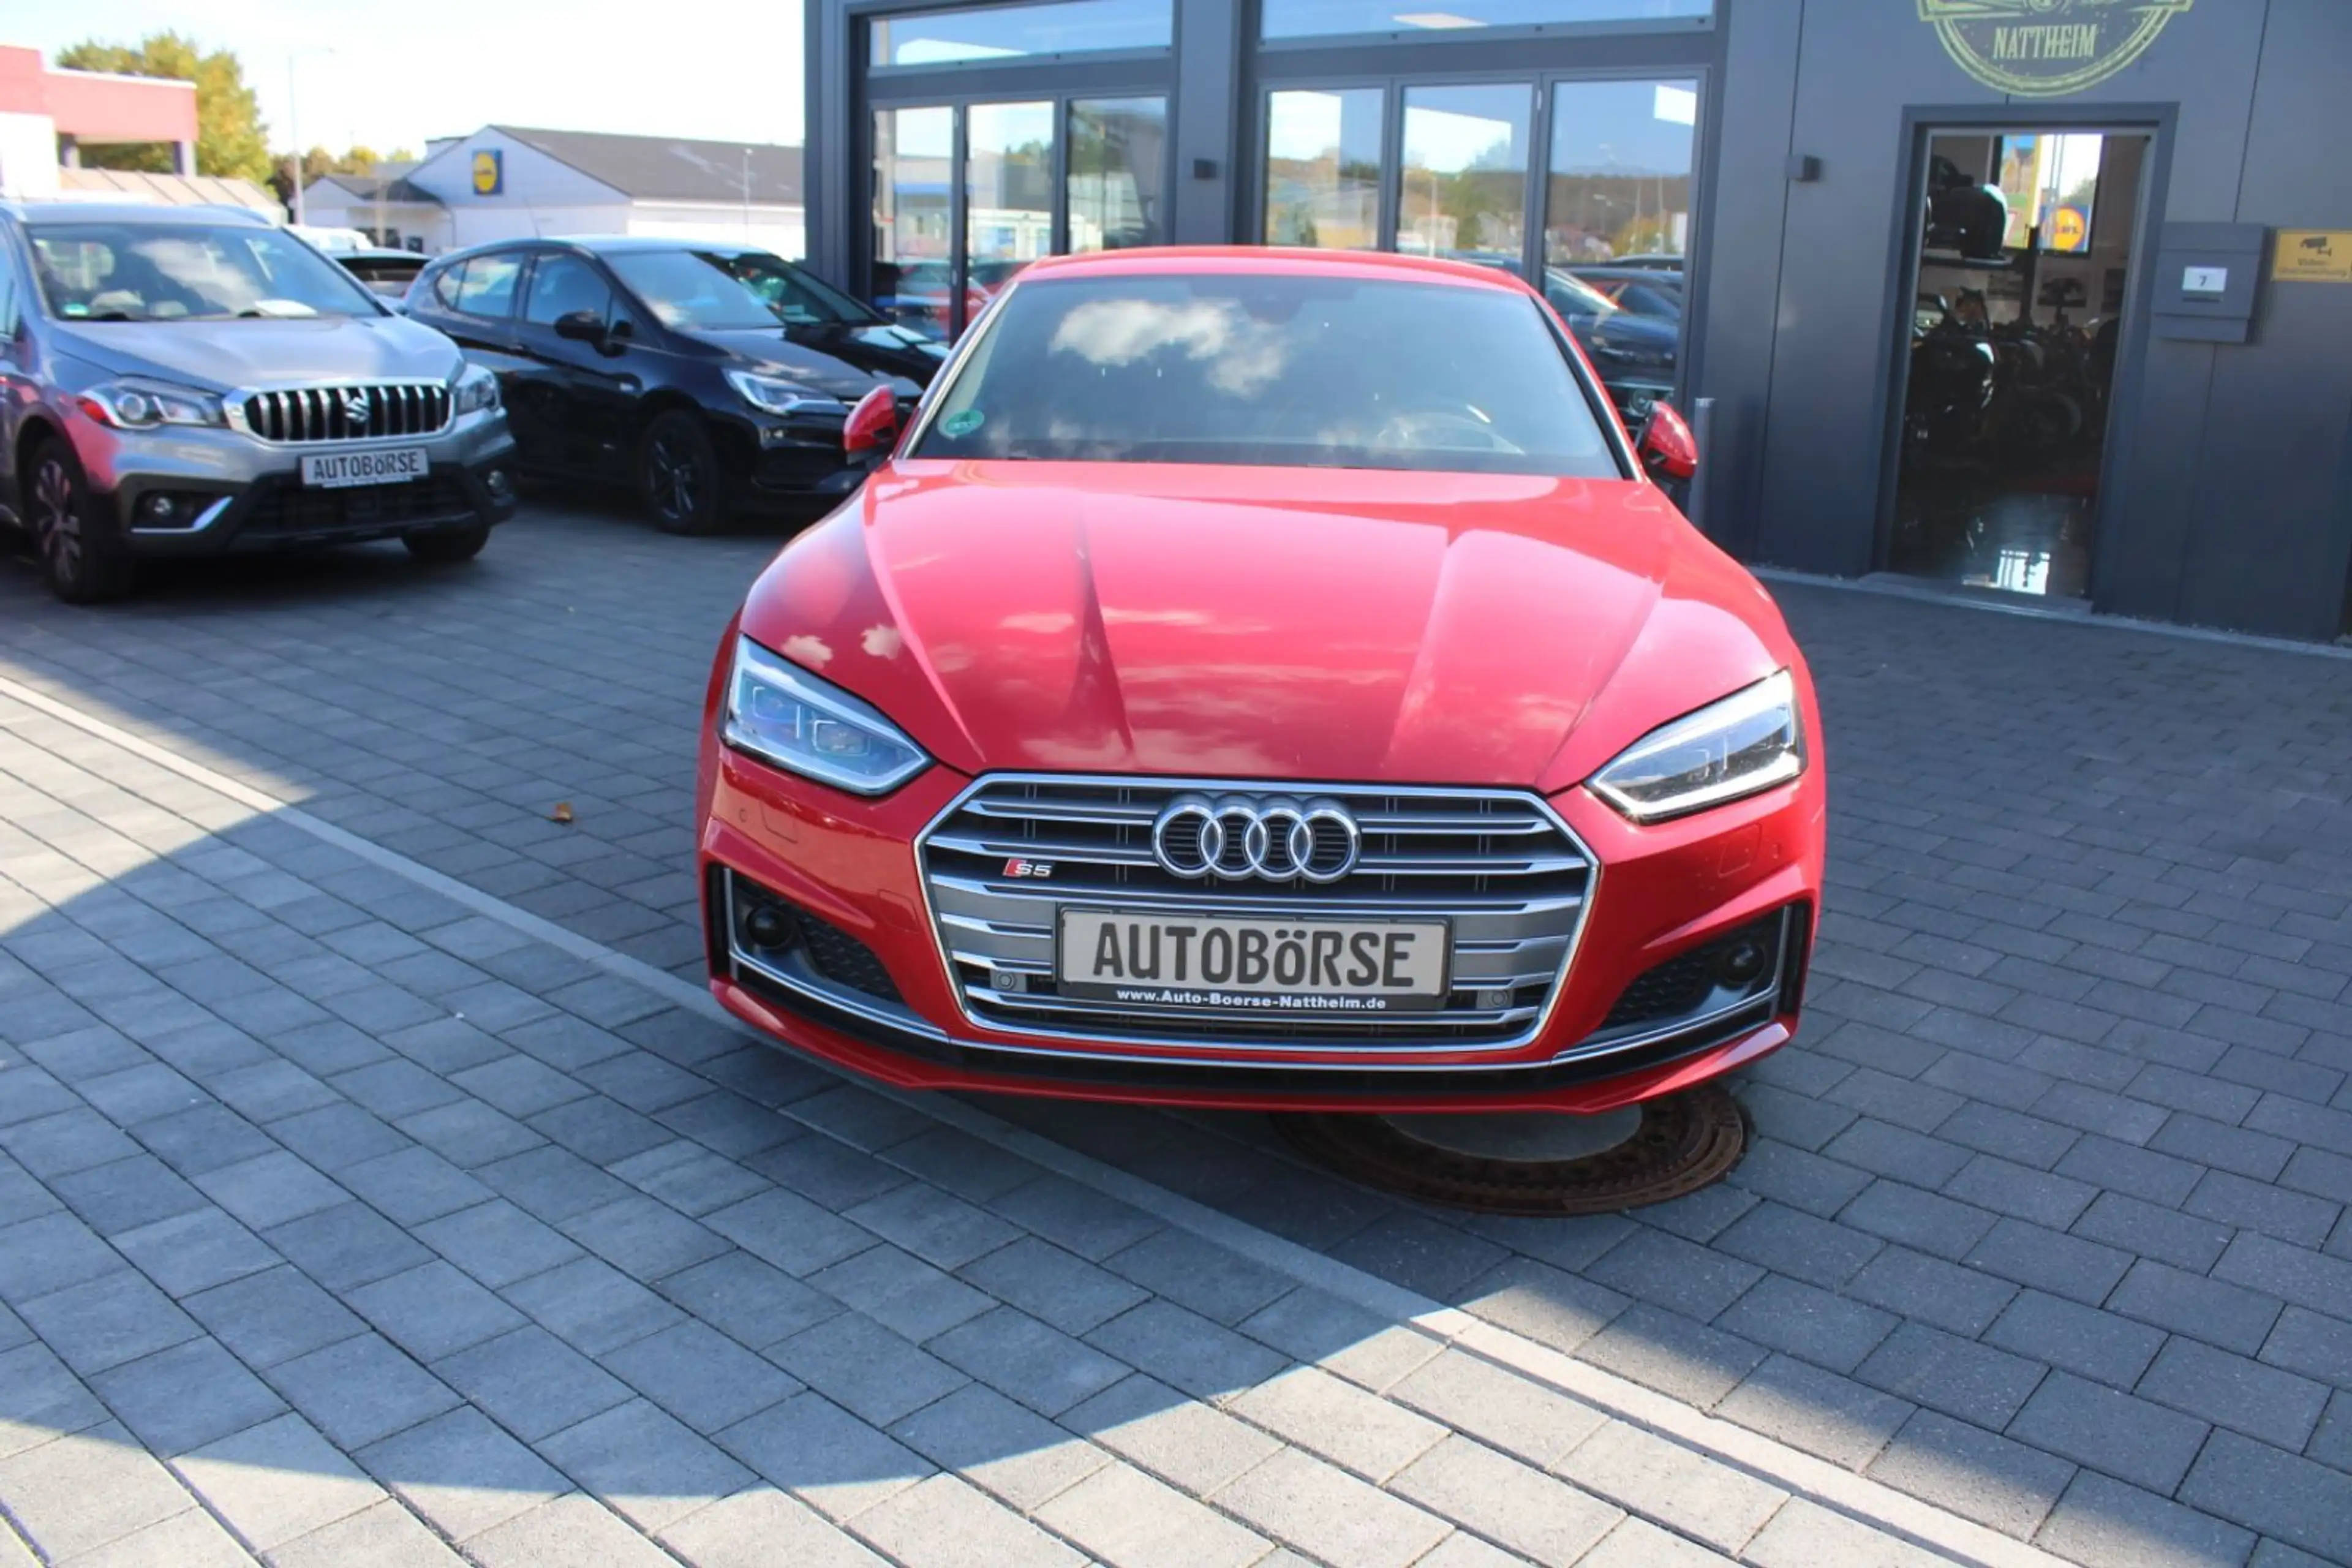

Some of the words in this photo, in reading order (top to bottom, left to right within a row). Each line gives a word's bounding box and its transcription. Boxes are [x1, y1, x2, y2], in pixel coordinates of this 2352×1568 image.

[1992, 23, 2098, 59] NATTHEIM
[2199, 275, 2207, 287] 7
[314, 451, 420, 480] AUTOBÖRSE
[1014, 863, 1052, 878] S5
[1093, 922, 1416, 987] AUTOBÖRSE
[1116, 989, 1386, 1009] www.Auto-Boerse-Nattheim.de
